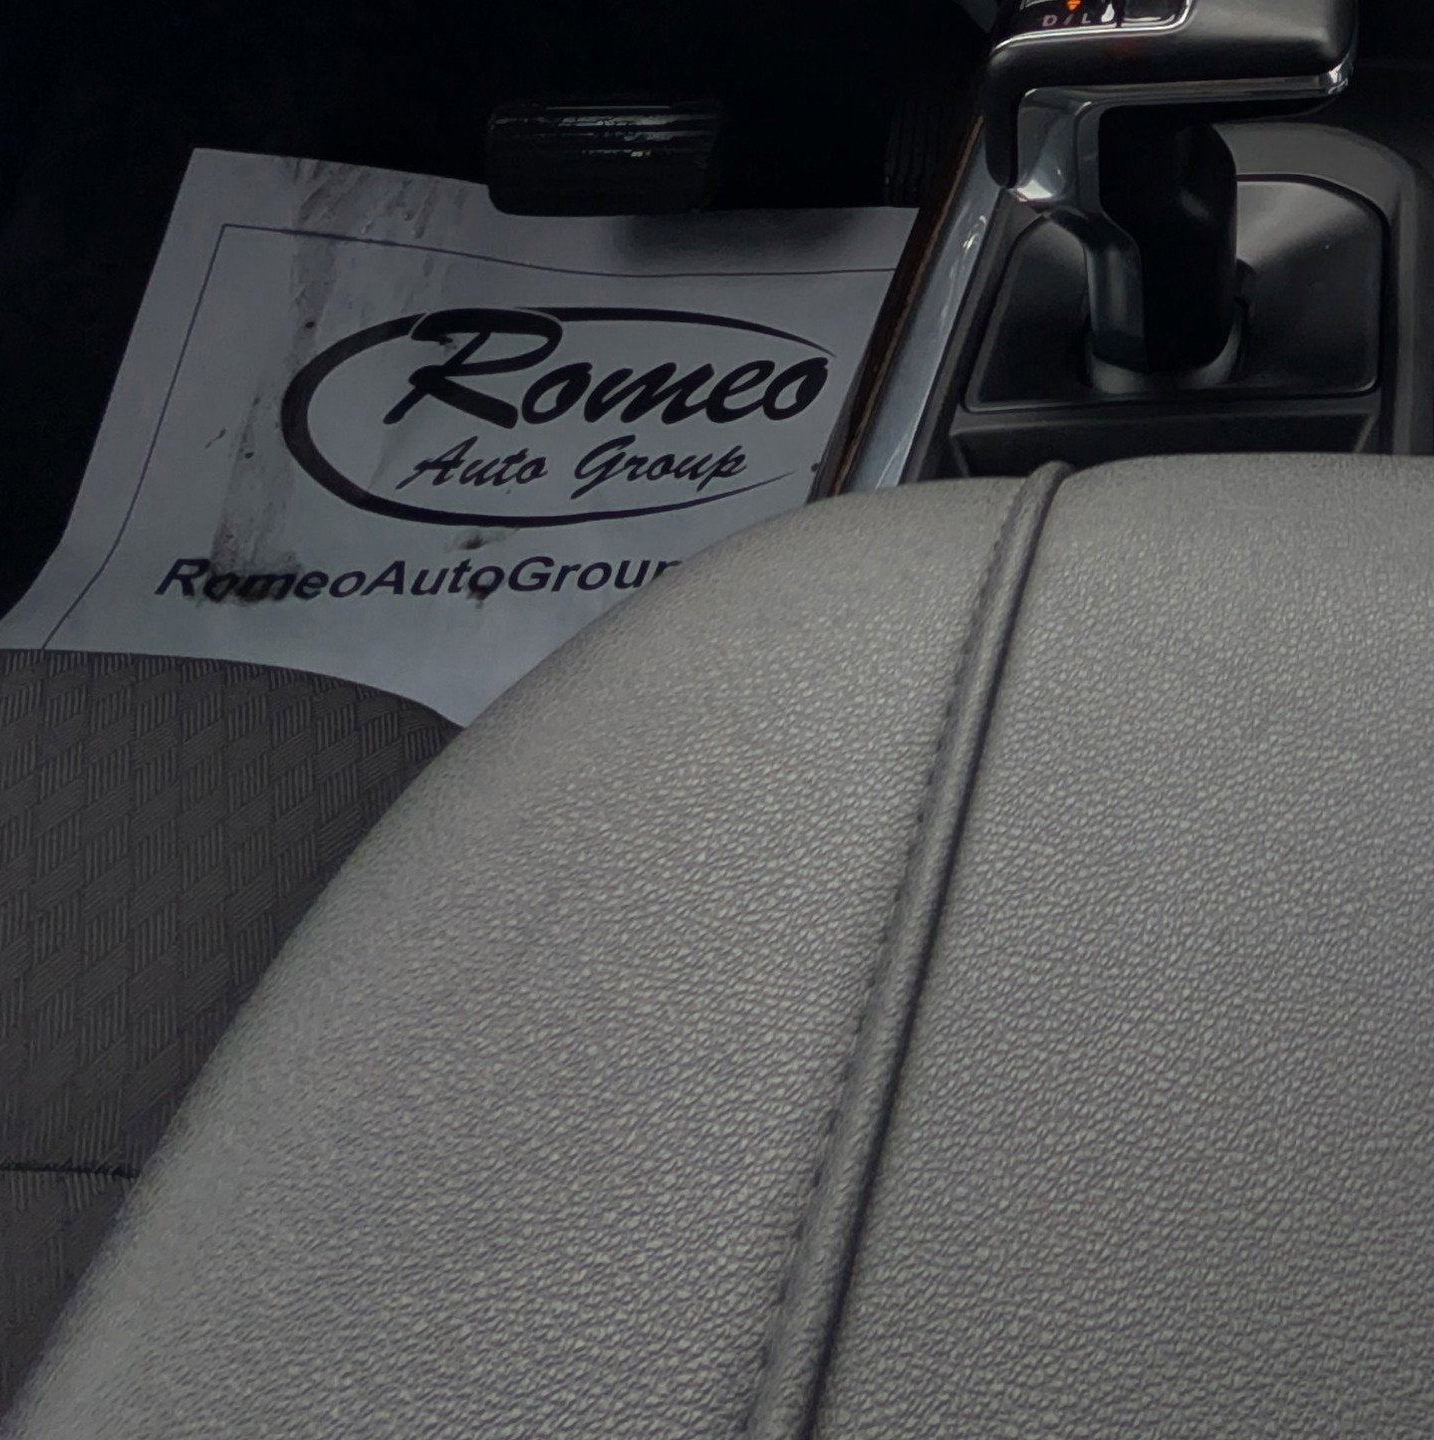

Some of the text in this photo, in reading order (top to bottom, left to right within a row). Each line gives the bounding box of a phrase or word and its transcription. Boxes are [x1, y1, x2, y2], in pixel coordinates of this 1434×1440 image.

[383, 307, 831, 430] Romeo
[396, 434, 750, 501] Auto Group
